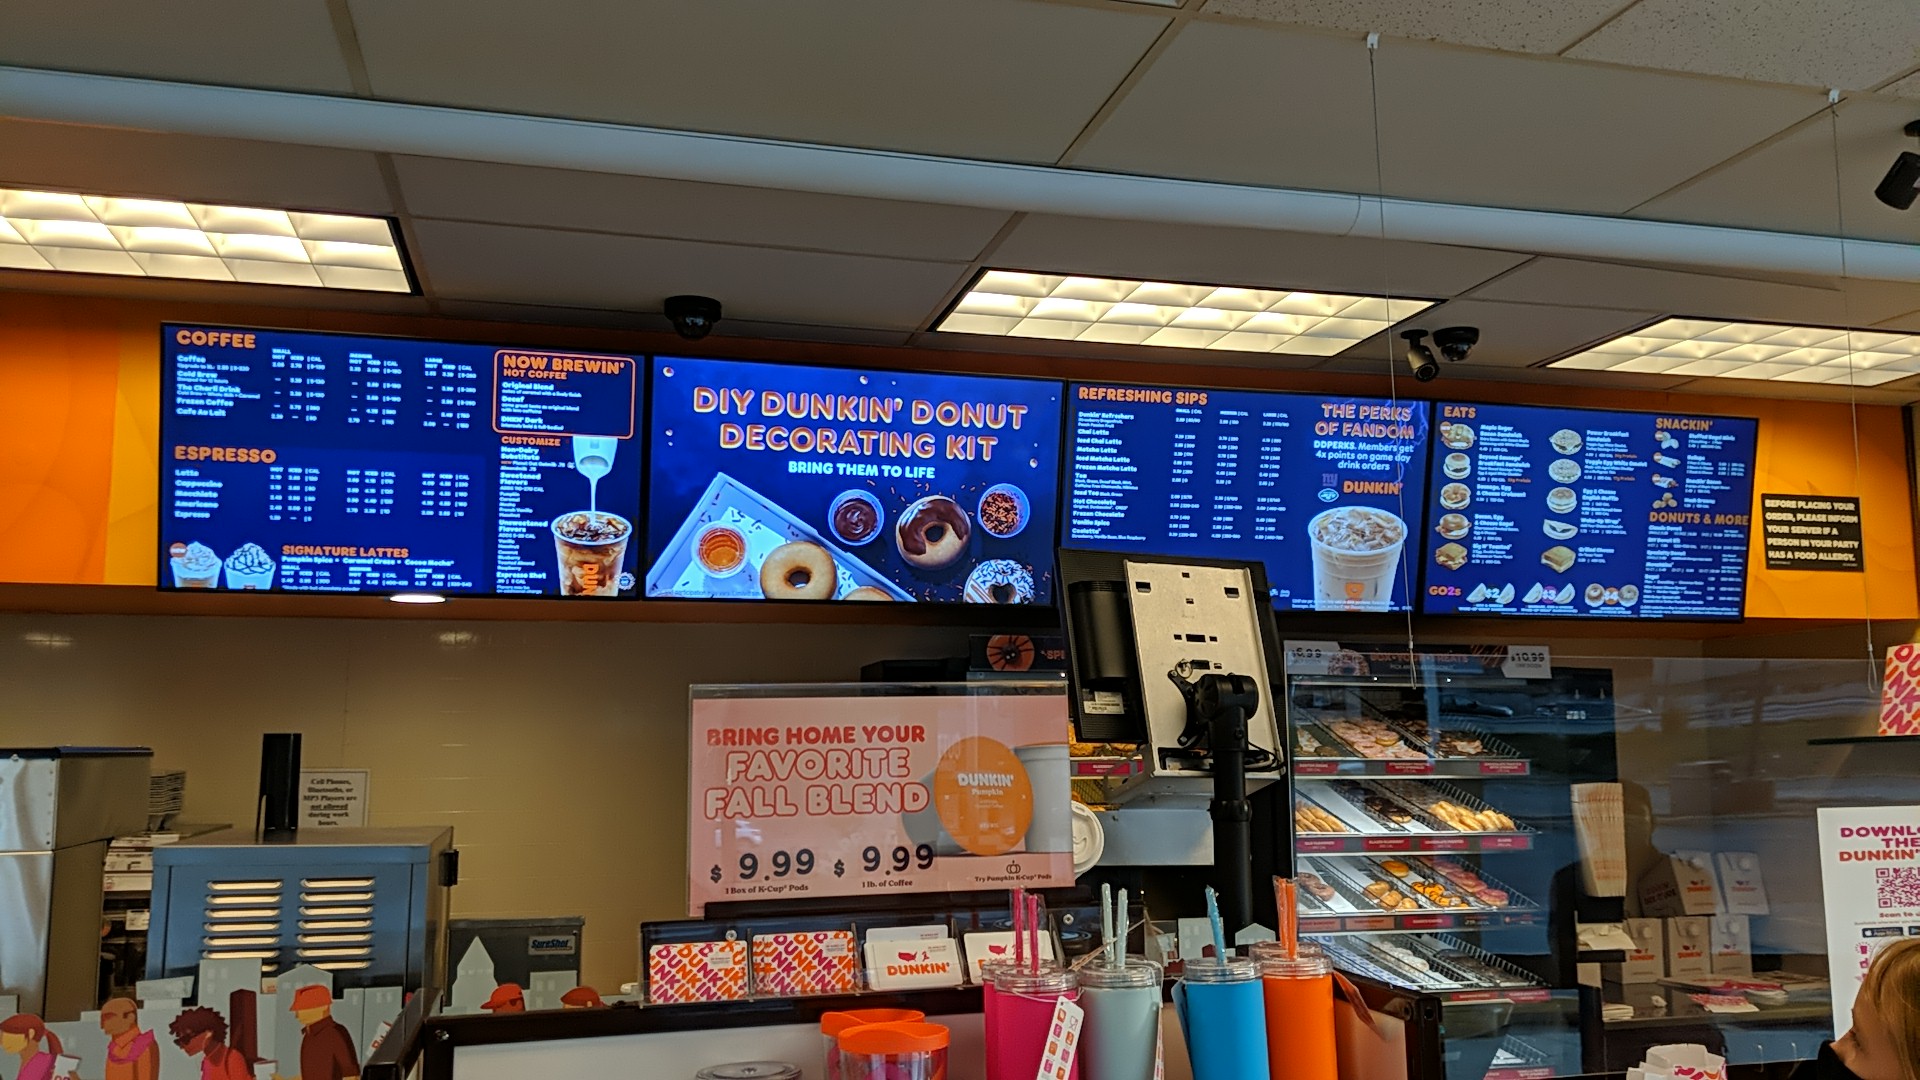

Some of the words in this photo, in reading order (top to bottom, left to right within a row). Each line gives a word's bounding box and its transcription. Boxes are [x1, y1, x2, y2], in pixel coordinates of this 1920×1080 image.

[176, 330, 256, 349] COFFEE
[177, 355, 206, 363] Coffee
[503, 355, 548, 370] NOW
[552, 358, 625, 375] BREWIN'
[177, 370, 196, 378] Cold
[197, 371, 218, 379] Brew
[503, 369, 526, 378] HOT
[528, 371, 567, 380] COFFEE
[194, 385, 218, 393] Charli
[219, 386, 241, 394] Drink
[502, 382, 532, 391] Original
[533, 383, 554, 391] Blend
[176, 397, 205, 405] Frozen
[1078, 387, 1172, 404] REFRESHING
[1175, 391, 1208, 406] SIPS
[693, 386, 755, 416] DIY
[761, 388, 904, 424] DUNKIN'
[911, 400, 1030, 430] DONUT
[1321, 403, 1356, 419] THE
[1358, 405, 1412, 422] PERKS
[1443, 405, 1476, 419] EATS
[1101, 412, 1134, 420] Refreshers
[1314, 420, 1339, 436] OF
[1342, 423, 1415, 439] FANDOM
[1655, 417, 1714, 431] SNACKIN'
[501, 436, 561, 447] CUSTOMIZE
[719, 423, 937, 458] DECORATING
[945, 433, 999, 462] KIT
[501, 446, 539, 455] Non-Dairy
[1357, 442, 1398, 453] Members
[1399, 444, 1414, 454] get
[174, 446, 277, 464] ESPRESSO
[501, 453, 540, 461] Substitute
[1315, 450, 1327, 459] 4x
[1327, 451, 1355, 461] points
[1356, 452, 1368, 460] on
[1369, 453, 1393, 462] game
[1395, 453, 1411, 463] day
[788, 460, 834, 476] BRING
[836, 462, 879, 477] THEM
[881, 464, 902, 478] TO
[904, 466, 937, 479] LIFE
[1337, 460, 1361, 469] drink
[1361, 462, 1390, 471] orders
[175, 469, 199, 477] Latte
[500, 472, 541, 480] Sweetened
[175, 479, 223, 488] Cappuccino
[1343, 480, 1403, 496] DUNKIN'
[175, 490, 218, 499] Macchiato
[175, 500, 219, 509] Americano
[1764, 499, 1797, 508] BEFORE
[1797, 500, 1832, 510] PLACING
[1833, 502, 1856, 511] YOUR
[174, 510, 210, 519] Espresso
[1649, 511, 1701, 524] DONUTS
[1704, 514, 1711, 525] &
[1714, 514, 1749, 526] MORE
[1765, 512, 1796, 523] ORDER,
[1796, 513, 1827, 522] PLEASE
[1827, 514, 1858, 524] INFORM
[499, 519, 548, 527] Unsweetened
[1766, 525, 1790, 533] YOUR
[1790, 526, 1822, 535] SERVER
[1823, 527, 1831, 535] IF
[1831, 527, 1839, 536] A
[1767, 538, 1800, 547] PERSON
[1800, 539, 1809, 547] IN
[1810, 539, 1833, 548] YOUR
[1833, 540, 1860, 549] PARTY
[282, 545, 357, 557] SIGNATURE
[359, 547, 409, 559] LATTES
[1767, 550, 1786, 559] HAS
[1786, 551, 1794, 559] A
[1794, 552, 1818, 560] FOOD
[1818, 552, 1856, 562] ALLERGY.
[282, 556, 312, 564] Pumpkin
[343, 557, 373, 565] Caramel
[1428, 585, 1462, 597] GO2s
[1485, 587, 1501, 599] $2
[1541, 588, 1556, 600] $3
[707, 727, 780, 747] BRING
[785, 725, 857, 745] HOME
[861, 724, 926, 744] YOUR
[726, 747, 911, 783] FAVORITE
[958, 773, 1014, 788] DUNKIN'
[971, 788, 1004, 796] Pumpkin
[704, 784, 800, 820] FALL
[805, 781, 931, 817] BLEND
[1881, 837, 1920, 849] THE
[833, 859, 846, 878] $
[861, 843, 935, 877] 9.99
[1839, 849, 1920, 862] DUNKIN'
[710, 864, 723, 884] $
[739, 847, 816, 882] 9.99
[866, 880, 879, 888] lb.
[889, 879, 913, 887] Coffee
[974, 875, 985, 883] Try
[985, 874, 1014, 882] Pumpkin
[730, 886, 746, 894] Box
[789, 883, 809, 892] Pods
[1879, 911, 1902, 919] Scan
[531, 939, 569, 949] SureShot
[887, 962, 949, 976] DUNKIN'
